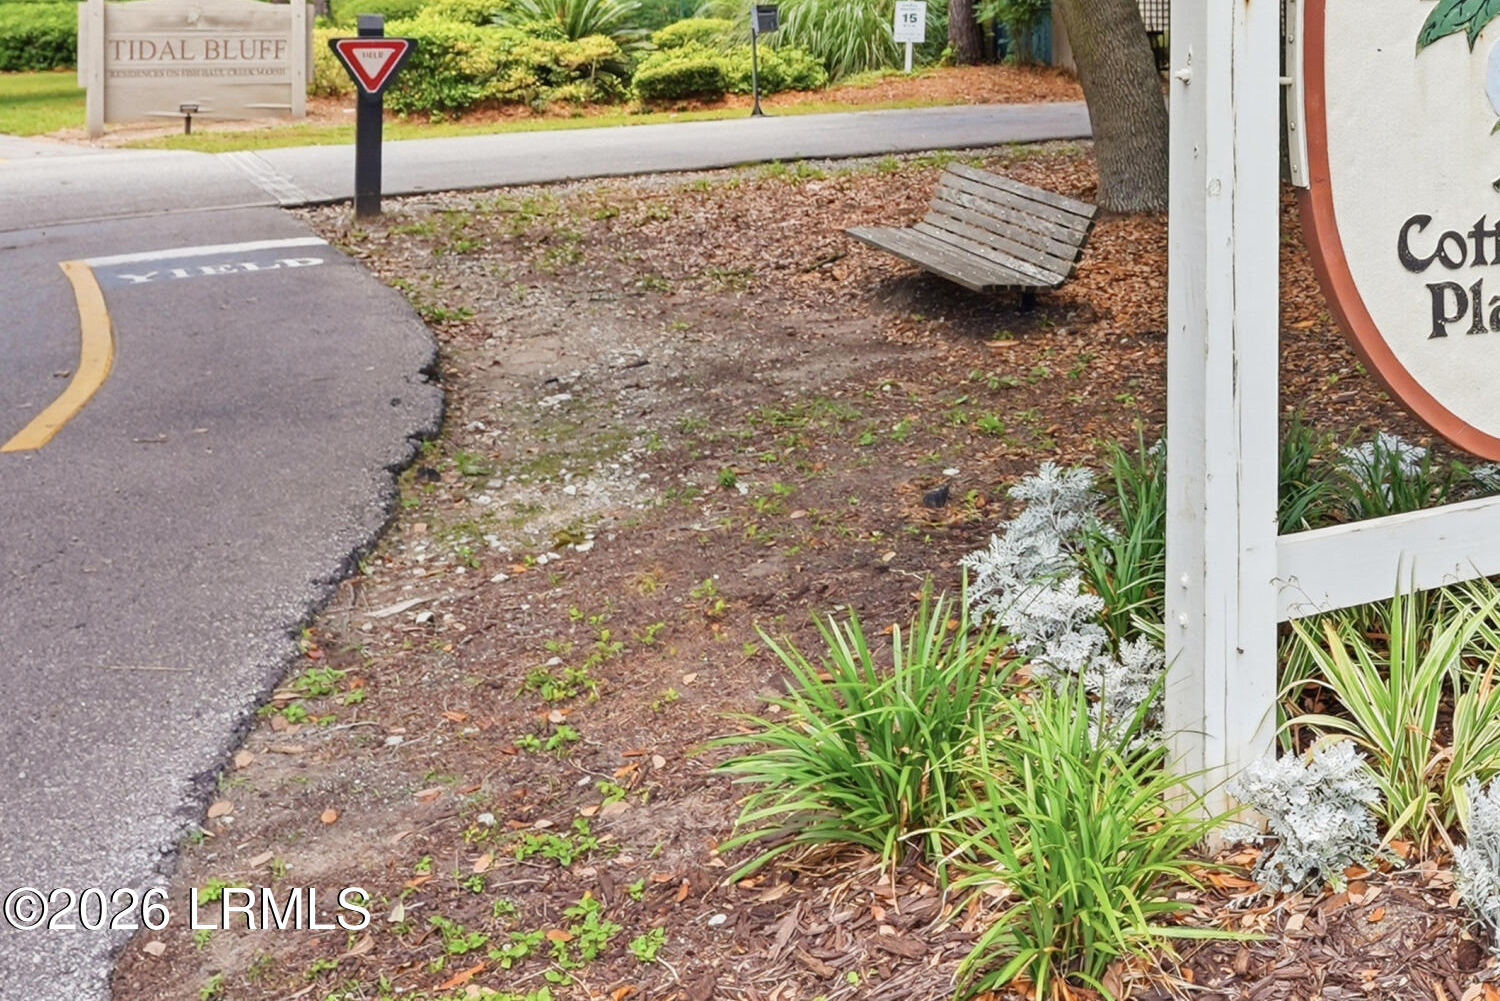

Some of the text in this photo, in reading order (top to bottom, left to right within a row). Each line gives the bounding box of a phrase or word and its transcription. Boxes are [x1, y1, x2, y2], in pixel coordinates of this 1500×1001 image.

[902, 13, 918, 23] 15
[109, 38, 287, 61] TIDAL BLUFF
[117, 257, 325, 284] YIELD
